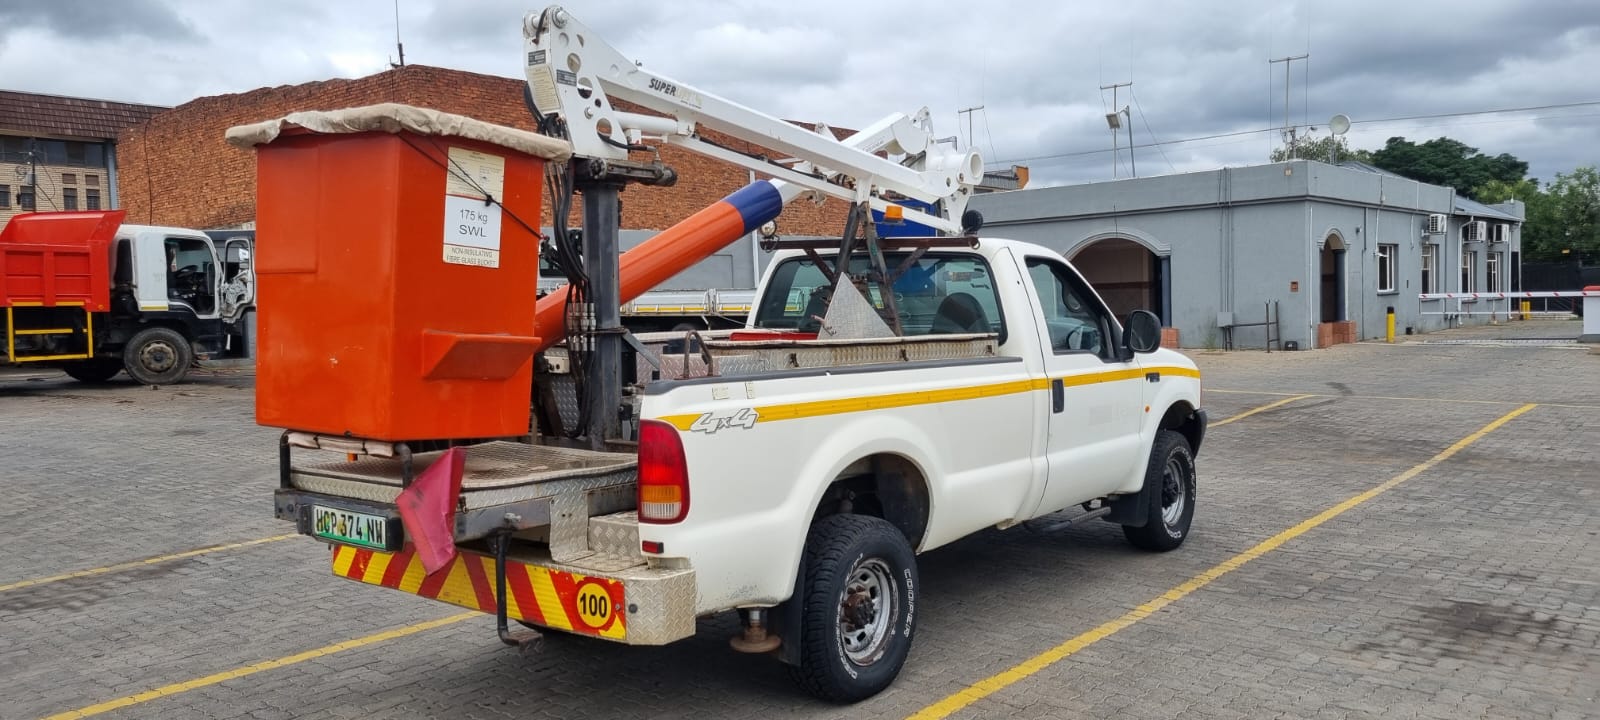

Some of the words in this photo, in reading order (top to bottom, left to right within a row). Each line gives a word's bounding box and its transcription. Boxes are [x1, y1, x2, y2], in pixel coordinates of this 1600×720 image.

[648, 78, 676, 96] SUPER
[460, 208, 476, 221] 175
[477, 211, 488, 224] kg
[460, 224, 488, 238] SWL
[690, 408, 758, 434] 4x4
[340, 514, 363, 540] 374
[366, 518, 382, 544] NW
[580, 592, 608, 618] 100
[904, 568, 914, 638] COOPER
